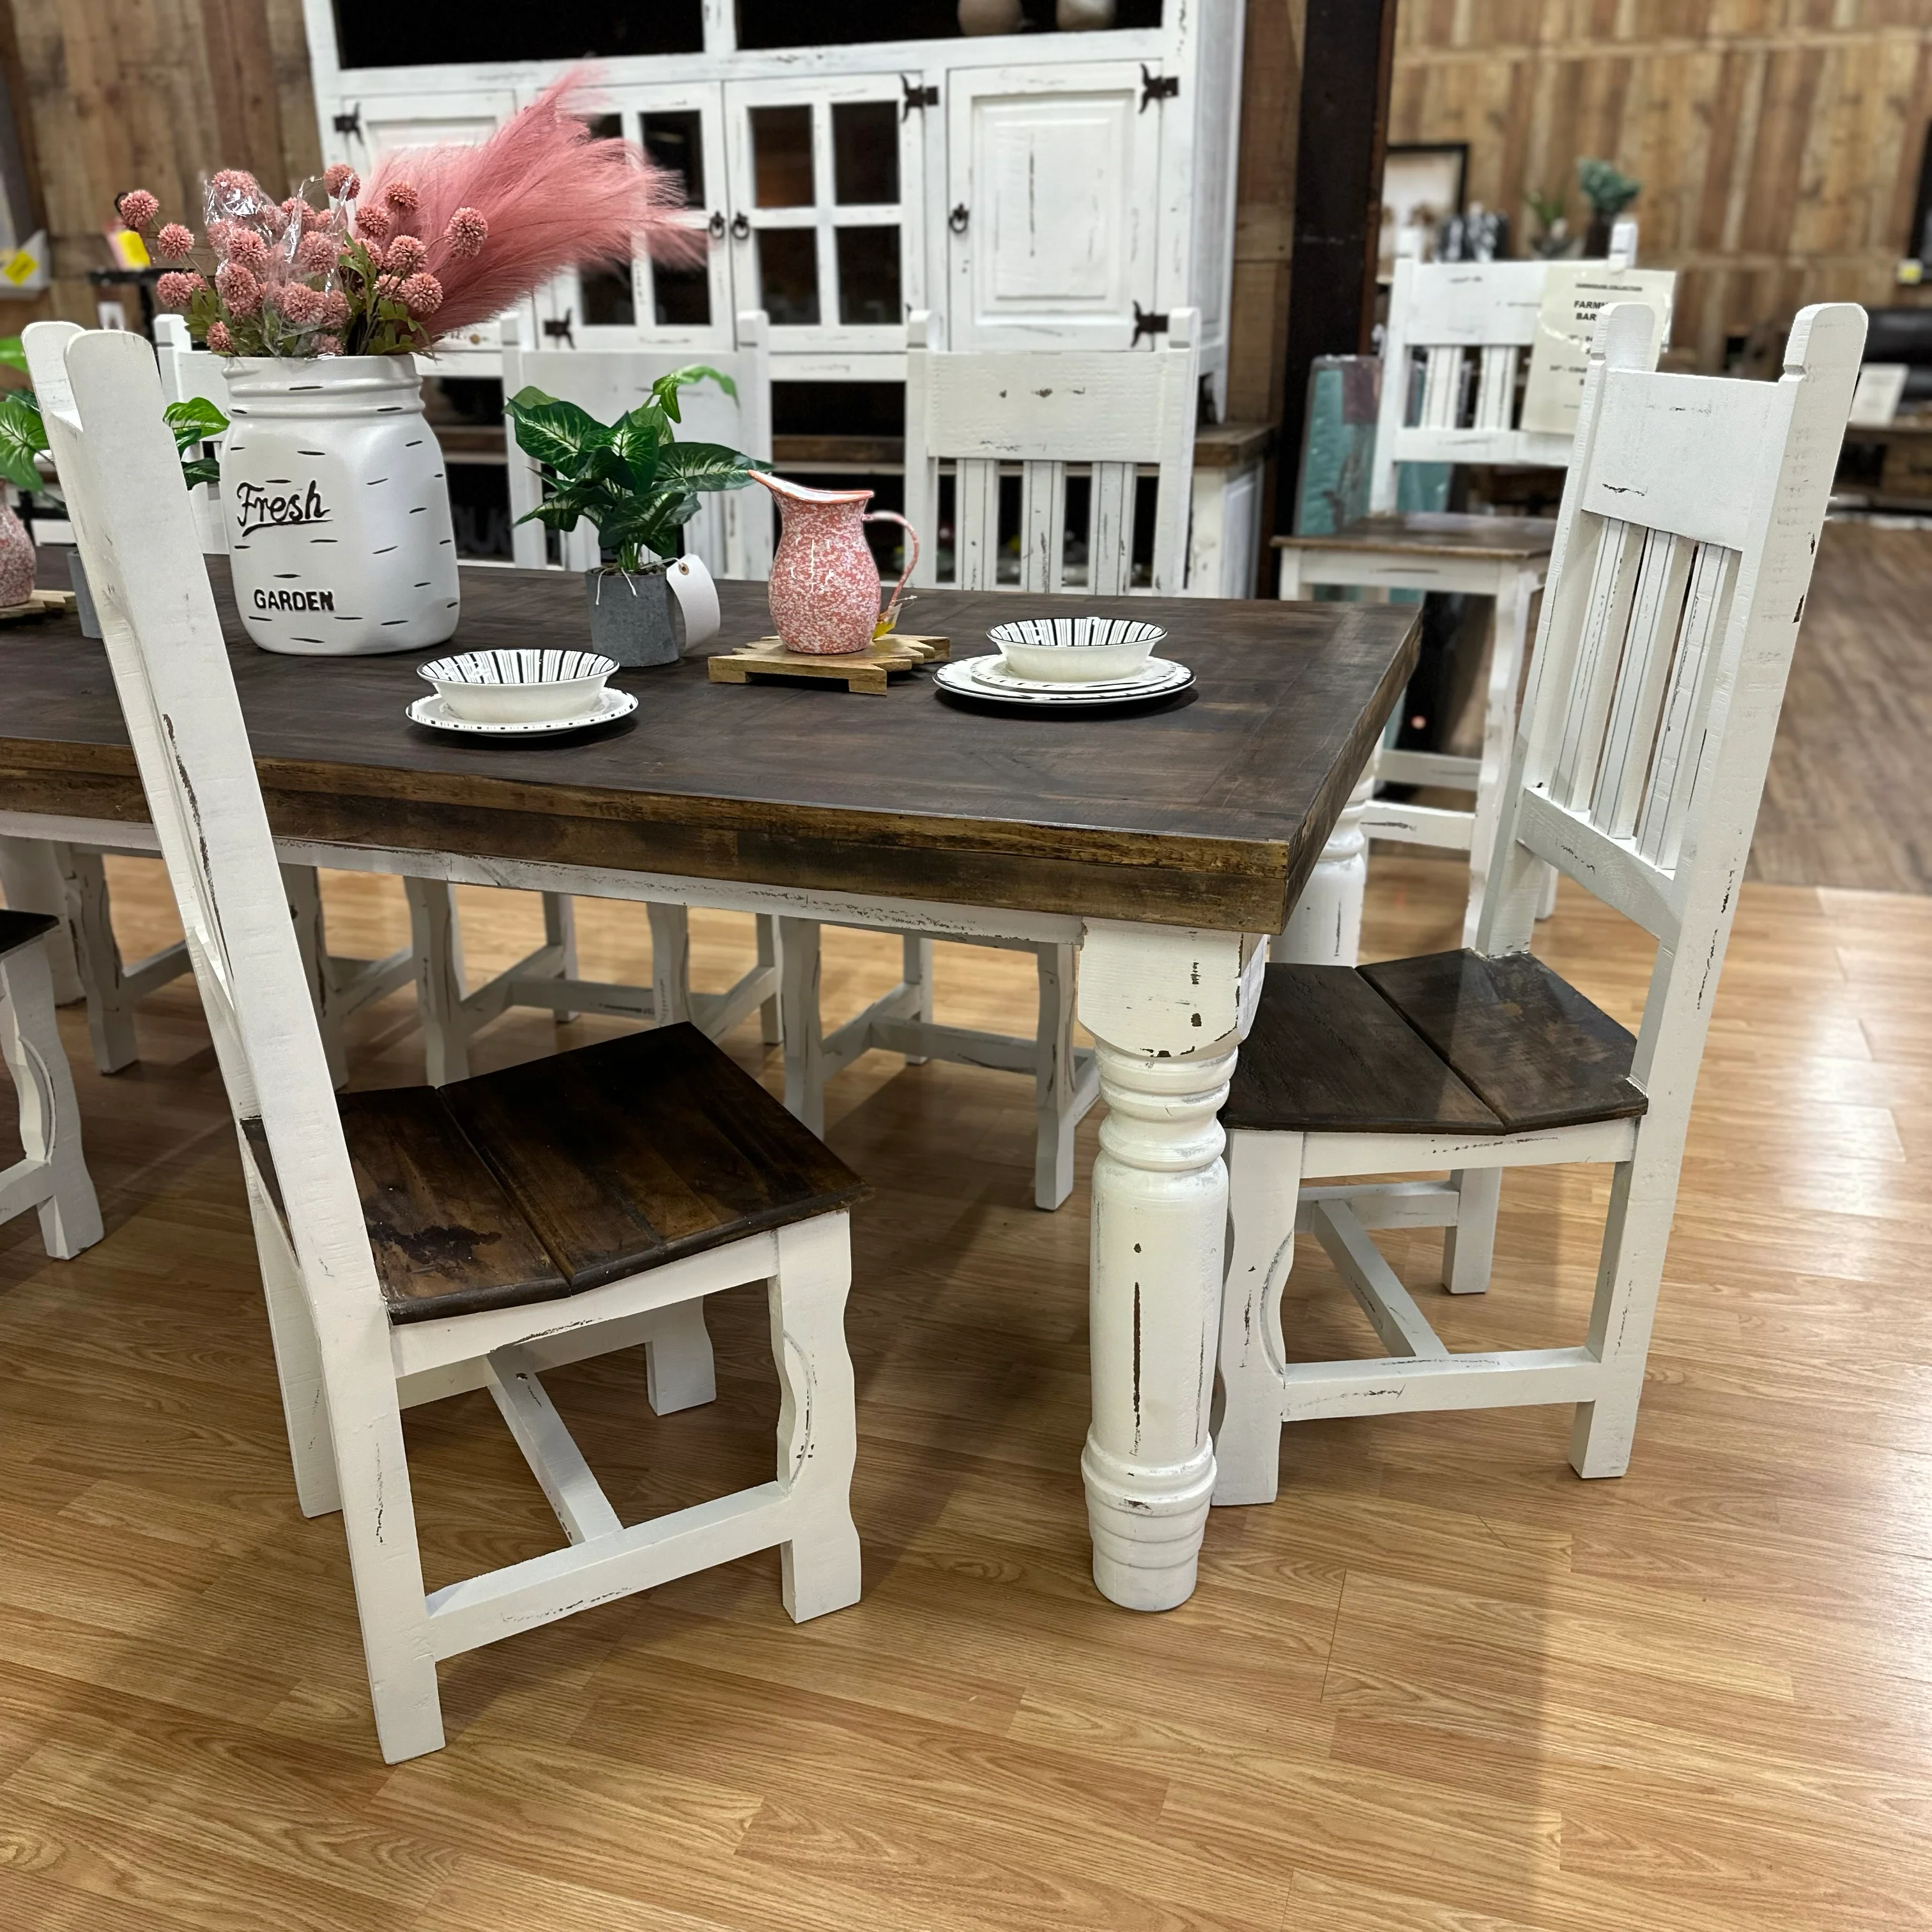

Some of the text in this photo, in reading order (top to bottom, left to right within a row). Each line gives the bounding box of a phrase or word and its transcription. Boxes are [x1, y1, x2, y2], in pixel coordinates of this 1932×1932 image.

[1576, 312, 1597, 321] BAR
[237, 480, 331, 527] Fresh
[254, 588, 335, 611] GARDEN
